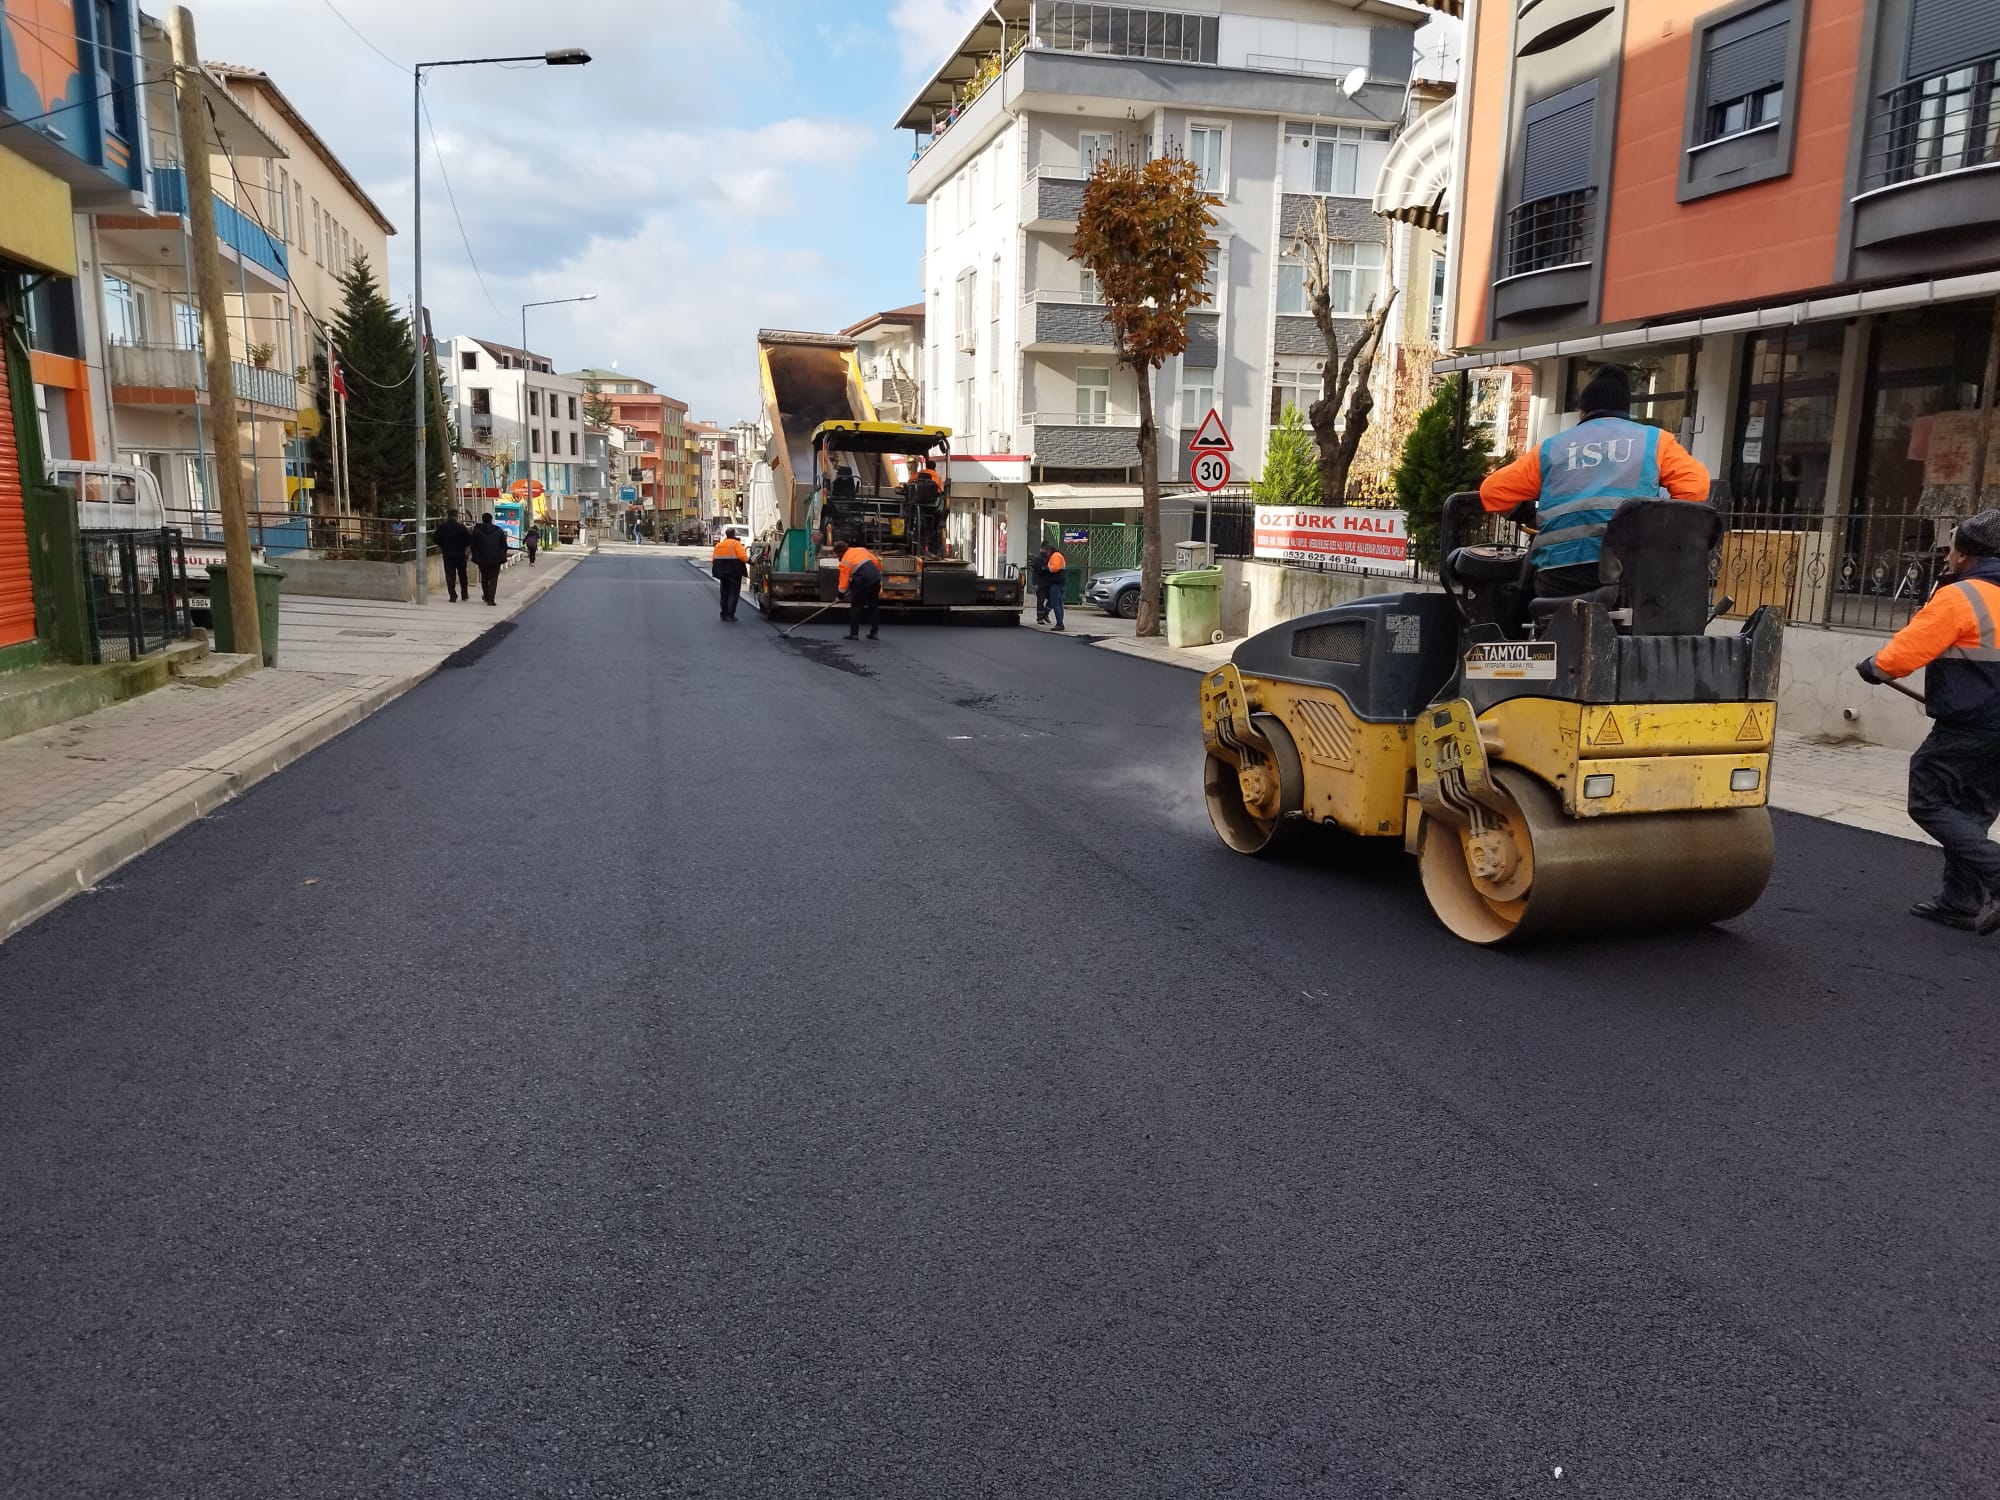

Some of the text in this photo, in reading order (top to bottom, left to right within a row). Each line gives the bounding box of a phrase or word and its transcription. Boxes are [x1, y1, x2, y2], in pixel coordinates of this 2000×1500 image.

[1201, 461, 1222, 480] 30
[1260, 512, 1394, 534] ÖZTÜRK HALI
[1283, 550, 1357, 566] 0532 625 46 94
[1483, 646, 1552, 661] TAMYOL ASFALT
